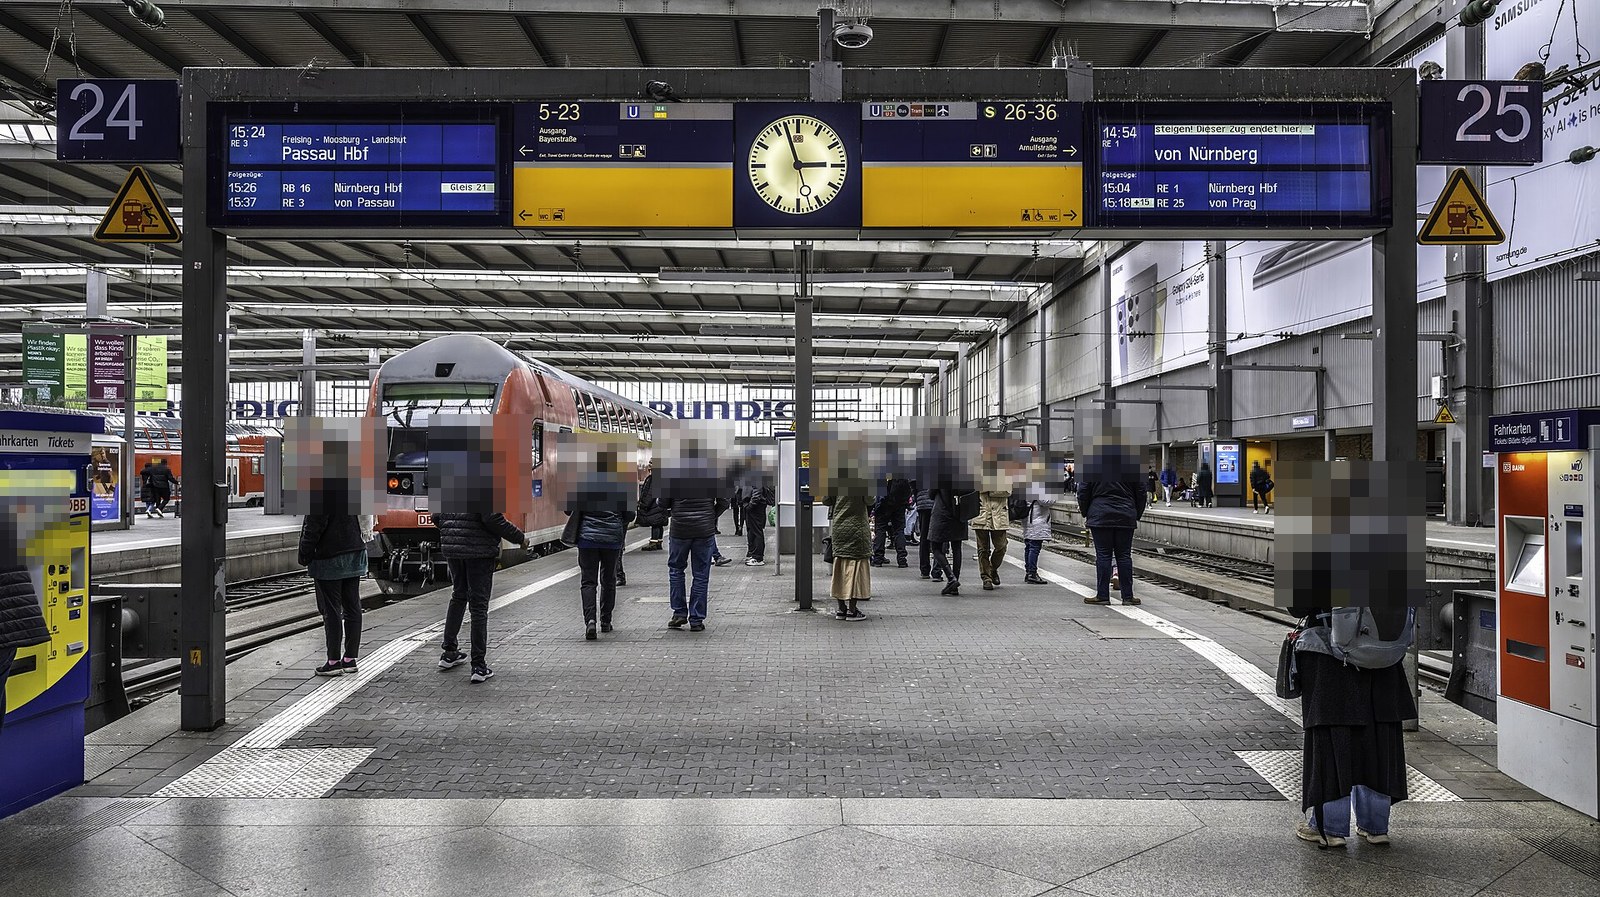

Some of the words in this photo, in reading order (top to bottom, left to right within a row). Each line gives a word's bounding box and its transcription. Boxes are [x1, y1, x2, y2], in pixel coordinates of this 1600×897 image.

[1494, 0, 1543, 31] SAMSUN
[69, 83, 143, 140] 24
[538, 103, 581, 121] 5-23
[629, 106, 638, 118] U
[872, 105, 880, 117] U
[985, 106, 996, 118] S
[1004, 103, 1058, 121] 26-36
[1455, 84, 1531, 143] 25
[1579, 109, 1588, 123] is
[231, 126, 266, 138] 15:24
[539, 127, 567, 136] Ausgang
[1102, 126, 1137, 139] 14:54
[1196, 125, 1226, 133] Dieser
[1229, 125, 1246, 134] Zug
[1250, 125, 1278, 133] endet
[230, 140, 240, 148] RE
[243, 140, 249, 148] 3
[282, 136, 312, 145] Freising
[323, 136, 361, 145] Moosburg
[371, 136, 407, 144] Landshut
[538, 136, 578, 144] Bayerstraße
[1029, 136, 1058, 144] Ausgang
[1102, 140, 1112, 148] RE
[1115, 140, 1120, 148] 1
[282, 146, 336, 161] Passau
[344, 146, 369, 161] Hbf
[1155, 149, 1182, 161] von
[1189, 146, 1258, 164] Nürnberg
[228, 171, 264, 179] Folgezüge:
[228, 182, 257, 193] 15:26
[282, 183, 296, 193] RB
[299, 183, 311, 193] 16
[334, 182, 380, 195] Nürnberg
[384, 182, 403, 193] Hbf
[1102, 182, 1131, 193] 15:04
[1156, 184, 1169, 193] RE
[1173, 184, 1179, 193] 1
[1208, 182, 1255, 196] Nürnberg
[1259, 182, 1278, 194] Hbf
[228, 197, 257, 208] 15:37
[282, 198, 295, 207] RE
[298, 198, 305, 207] 3
[334, 200, 353, 208] von
[357, 197, 395, 208] Passau
[1102, 197, 1131, 208] 15:18
[1156, 198, 1169, 208] RE
[1173, 198, 1185, 208] 25
[1209, 200, 1228, 208] von
[1232, 198, 1257, 210] Prag
[1494, 422, 1532, 436] Fahrkarten
[47, 436, 75, 448] Tickets
